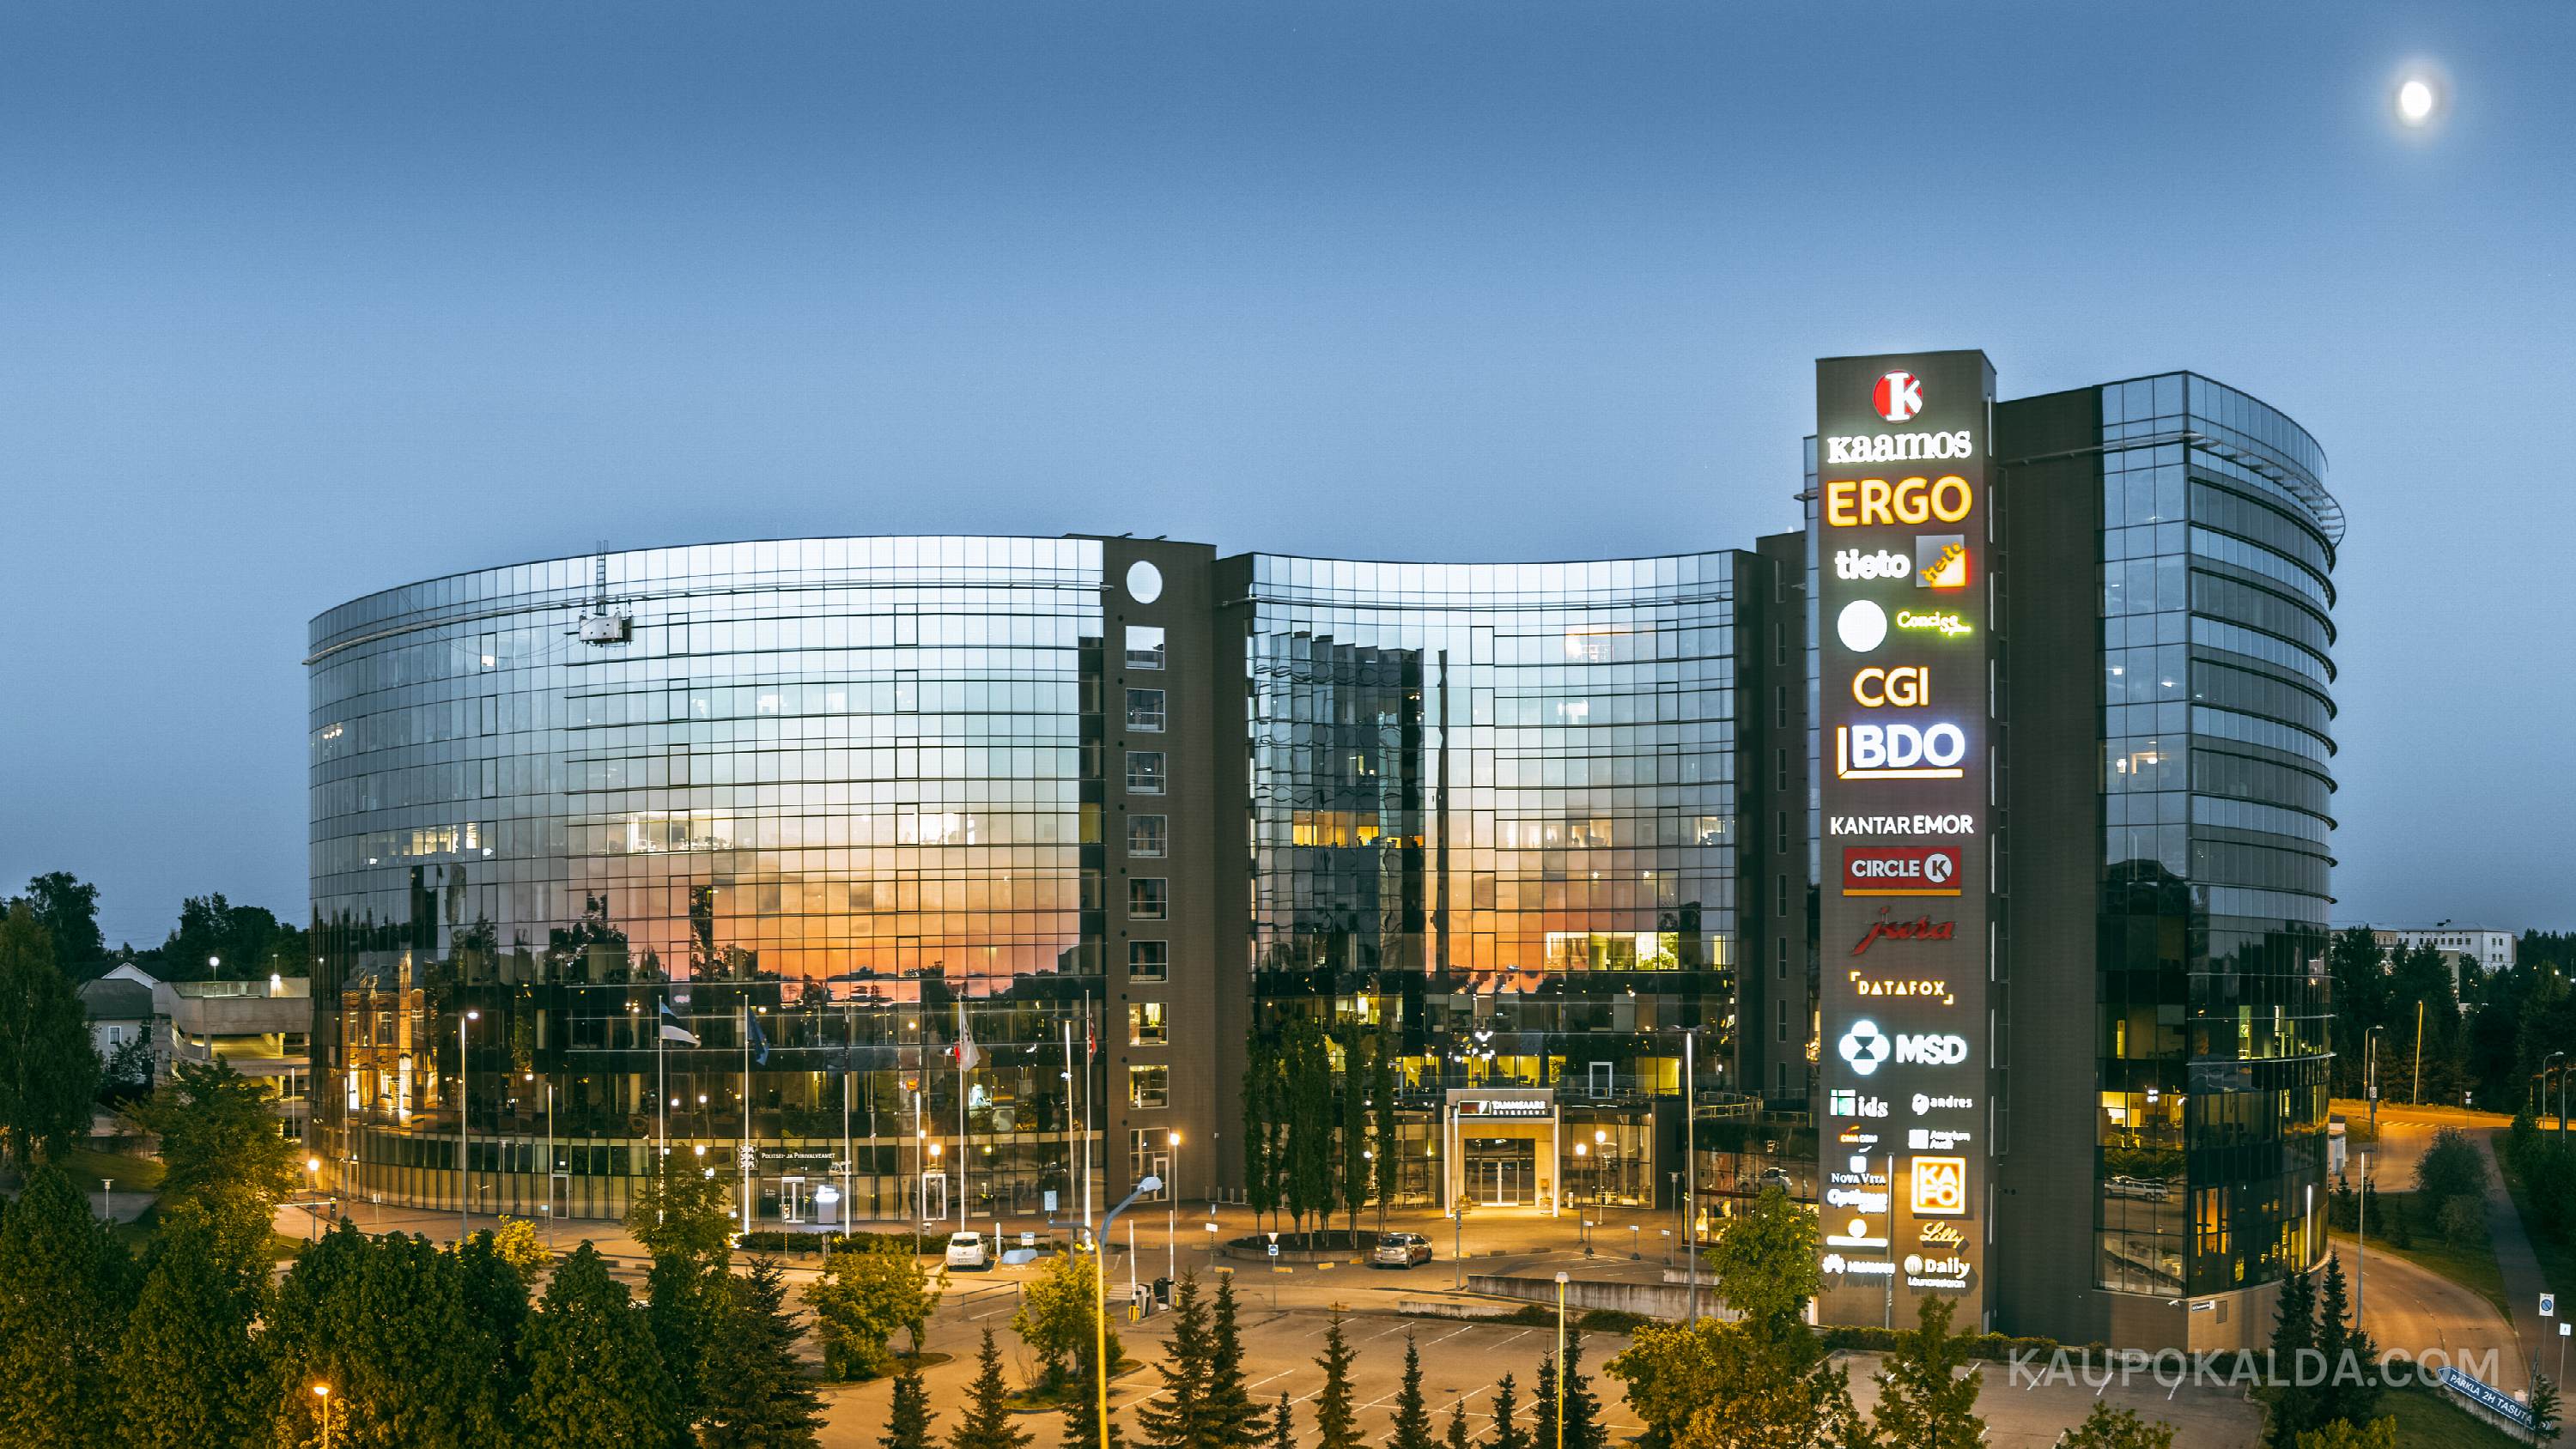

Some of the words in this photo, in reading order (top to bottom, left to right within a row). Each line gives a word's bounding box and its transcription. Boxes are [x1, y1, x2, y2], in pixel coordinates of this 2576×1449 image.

[1827, 476, 1972, 527] ERGO
[1834, 549, 1911, 580] tieto
[1852, 665, 1929, 707] CGI
[1851, 723, 1965, 768] BDO
[1830, 816, 1911, 835] KANTAR
[1913, 815, 1974, 834] EMOR
[1851, 859, 1920, 877] CIRCLE
[1851, 906, 1955, 956] jura
[1858, 980, 1945, 995] DATAFOX
[1896, 1034, 1967, 1064] MSD
[1858, 1095, 1889, 1117] ids
[1831, 1173, 1860, 1184] NOVA
[1861, 1173, 1886, 1184] VITA
[1919, 1221, 1965, 1249] Lilly
[1924, 1257, 1971, 1279] Daily
[2450, 1374, 2480, 1396] PARKLA
[2482, 1391, 2495, 1404] 2H
[2497, 1397, 2532, 1425] TASUTA
